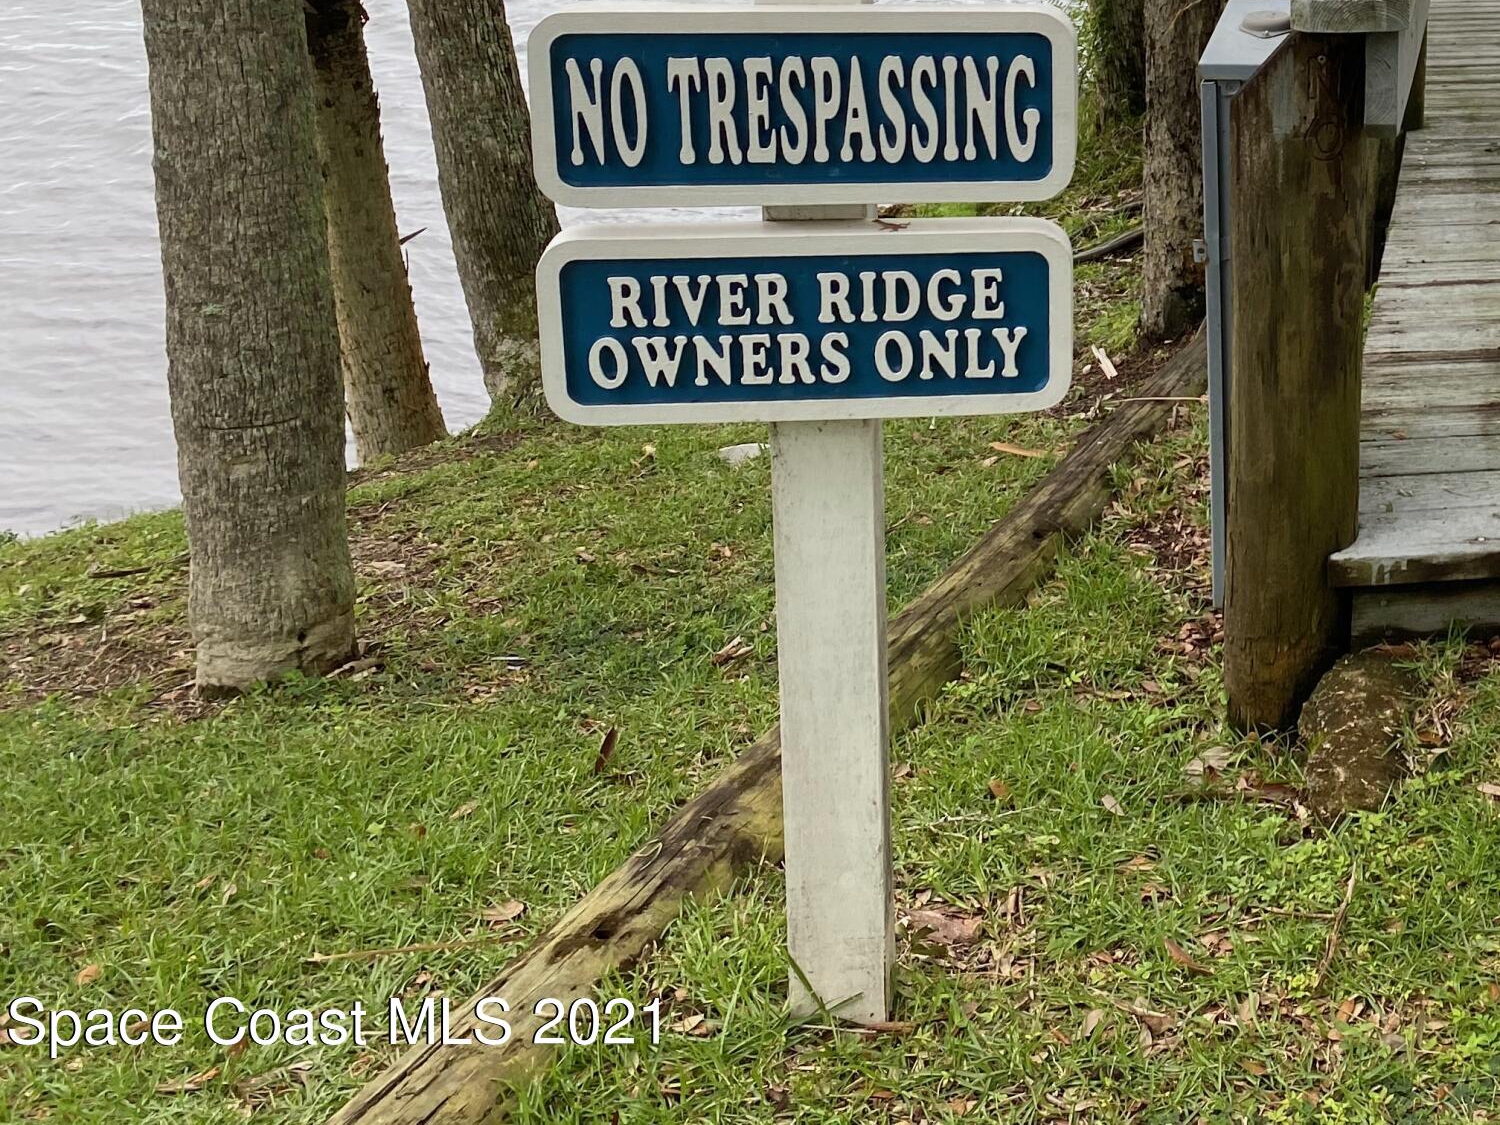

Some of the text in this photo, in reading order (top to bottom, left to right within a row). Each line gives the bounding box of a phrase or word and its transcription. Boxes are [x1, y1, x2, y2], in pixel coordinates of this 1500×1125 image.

[564, 54, 1041, 167] NO TRESPASSING
[606, 268, 1006, 328] RIVER RIDGE
[588, 326, 1029, 390] OWNERS ONLY
